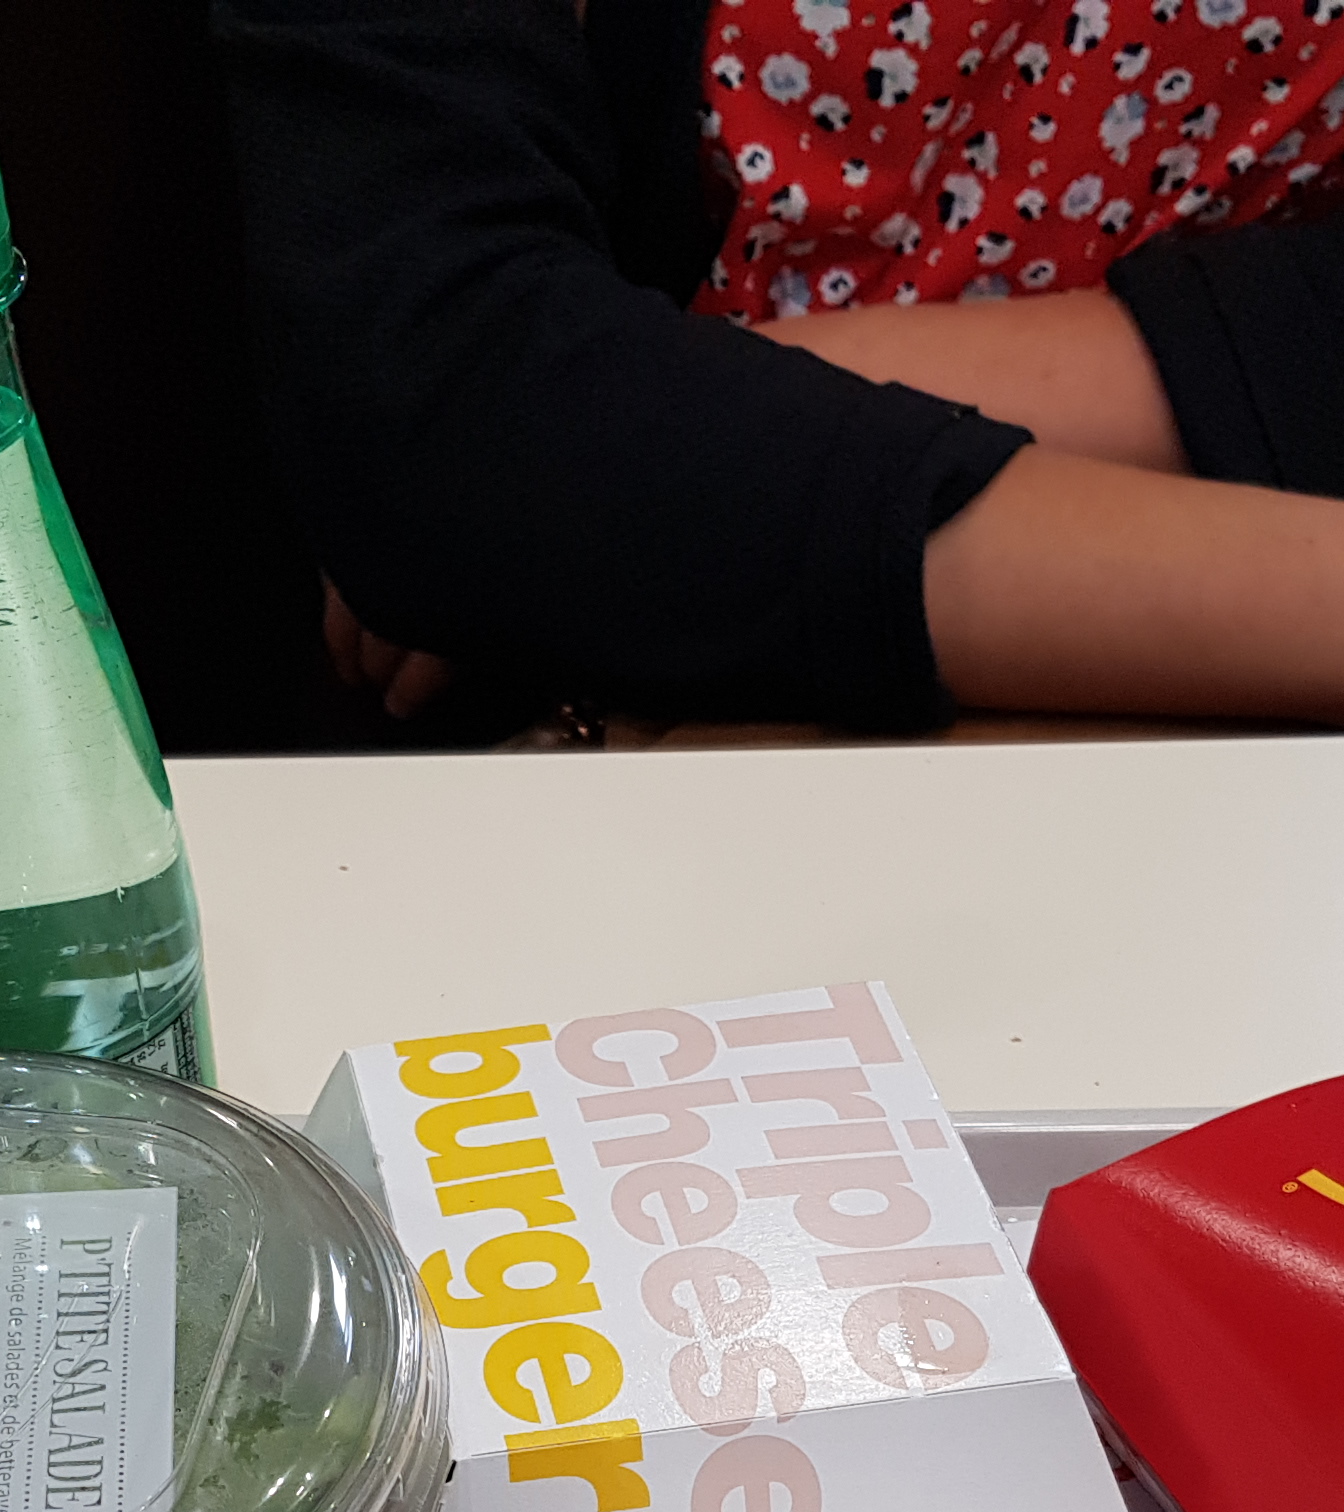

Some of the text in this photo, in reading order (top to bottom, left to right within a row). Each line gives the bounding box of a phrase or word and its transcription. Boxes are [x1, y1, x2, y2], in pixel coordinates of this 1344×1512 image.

[715, 981, 1005, 1391] Triple
[7, 1306, 28, 1326] de
[2, 1330, 27, 1389] salades
[43, 1235, 113, 1510] P'TITE SALADE
[0, 1414, 21, 1435] de
